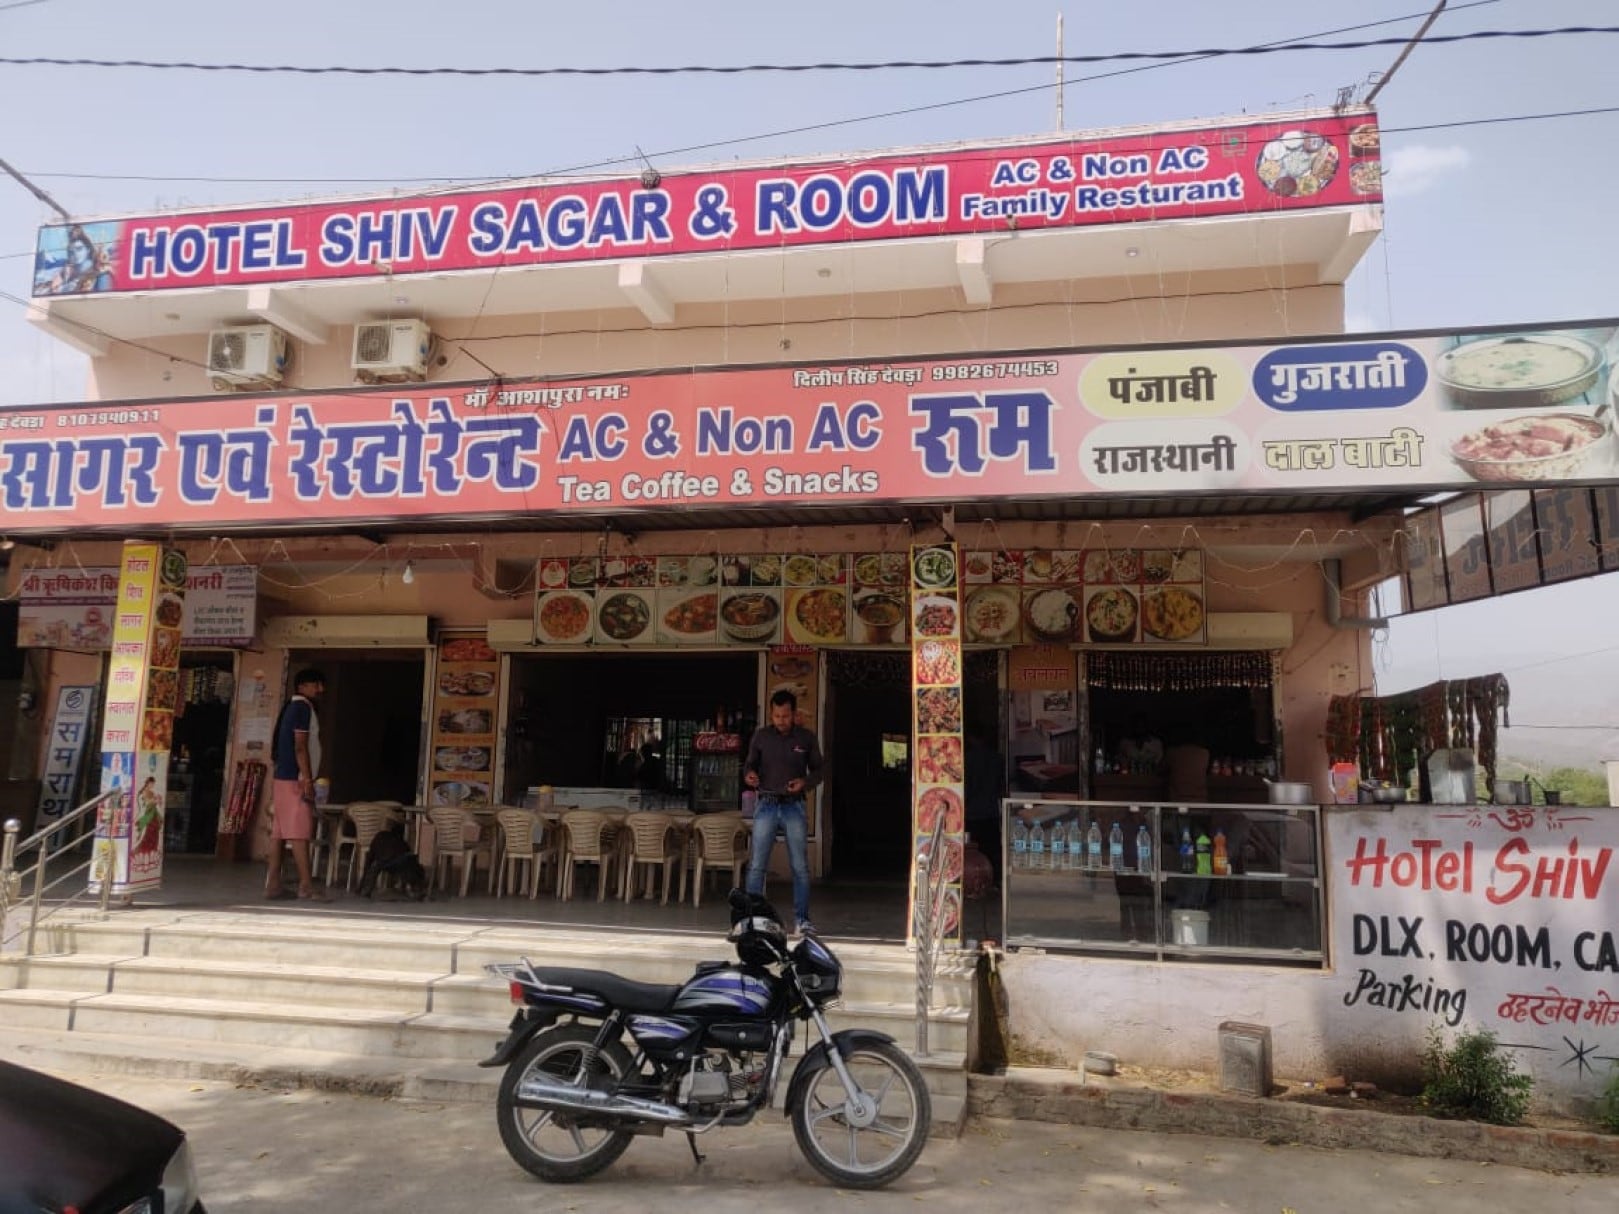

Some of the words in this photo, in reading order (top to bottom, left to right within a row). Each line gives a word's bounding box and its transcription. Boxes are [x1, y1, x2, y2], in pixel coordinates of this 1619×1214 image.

[994, 162, 1038, 185] AC
[1049, 158, 1073, 181] &
[1085, 155, 1148, 178] Non
[1159, 147, 1207, 172] AC
[962, 191, 1067, 218] Family
[1078, 176, 1241, 210] Resturant
[129, 218, 305, 280] HOTEL
[319, 206, 456, 264] SHIV
[469, 190, 672, 254] SAGAR
[690, 188, 735, 240] &
[755, 168, 947, 231] ROOM
[793, 369, 843, 388] दिलीप
[846, 366, 879, 386] सिंह
[931, 361, 1060, 382] 9982674453
[1108, 366, 1218, 404] पंजाबी
[1270, 350, 1408, 404] गुजराती
[495, 387, 585, 409] आशापुरा
[586, 384, 630, 401] नमः
[57, 410, 161, 428] 8107940911
[557, 413, 628, 463] AC
[644, 409, 679, 458] &
[696, 406, 794, 456] Non
[806, 401, 883, 453] AC
[908, 390, 1060, 478] रूम
[0, 436, 167, 512] सागर
[177, 405, 277, 506] एवं
[289, 399, 546, 501] रेस्टोरेन्ट
[1092, 434, 1238, 475] राजस्थानी
[1262, 438, 1339, 472] दाल
[1340, 426, 1425, 469] बाटी
[557, 476, 611, 503] Tea
[620, 470, 720, 500] Coffee
[729, 468, 752, 496] &
[763, 465, 879, 496] Snacks
[24, 574, 41, 592] श्री
[100, 573, 120, 593] कि
[184, 572, 223, 590] शनरी
[127, 556, 150, 571] होटल
[126, 582, 144, 598] शिव
[1344, 969, 1467, 1027] Parking
